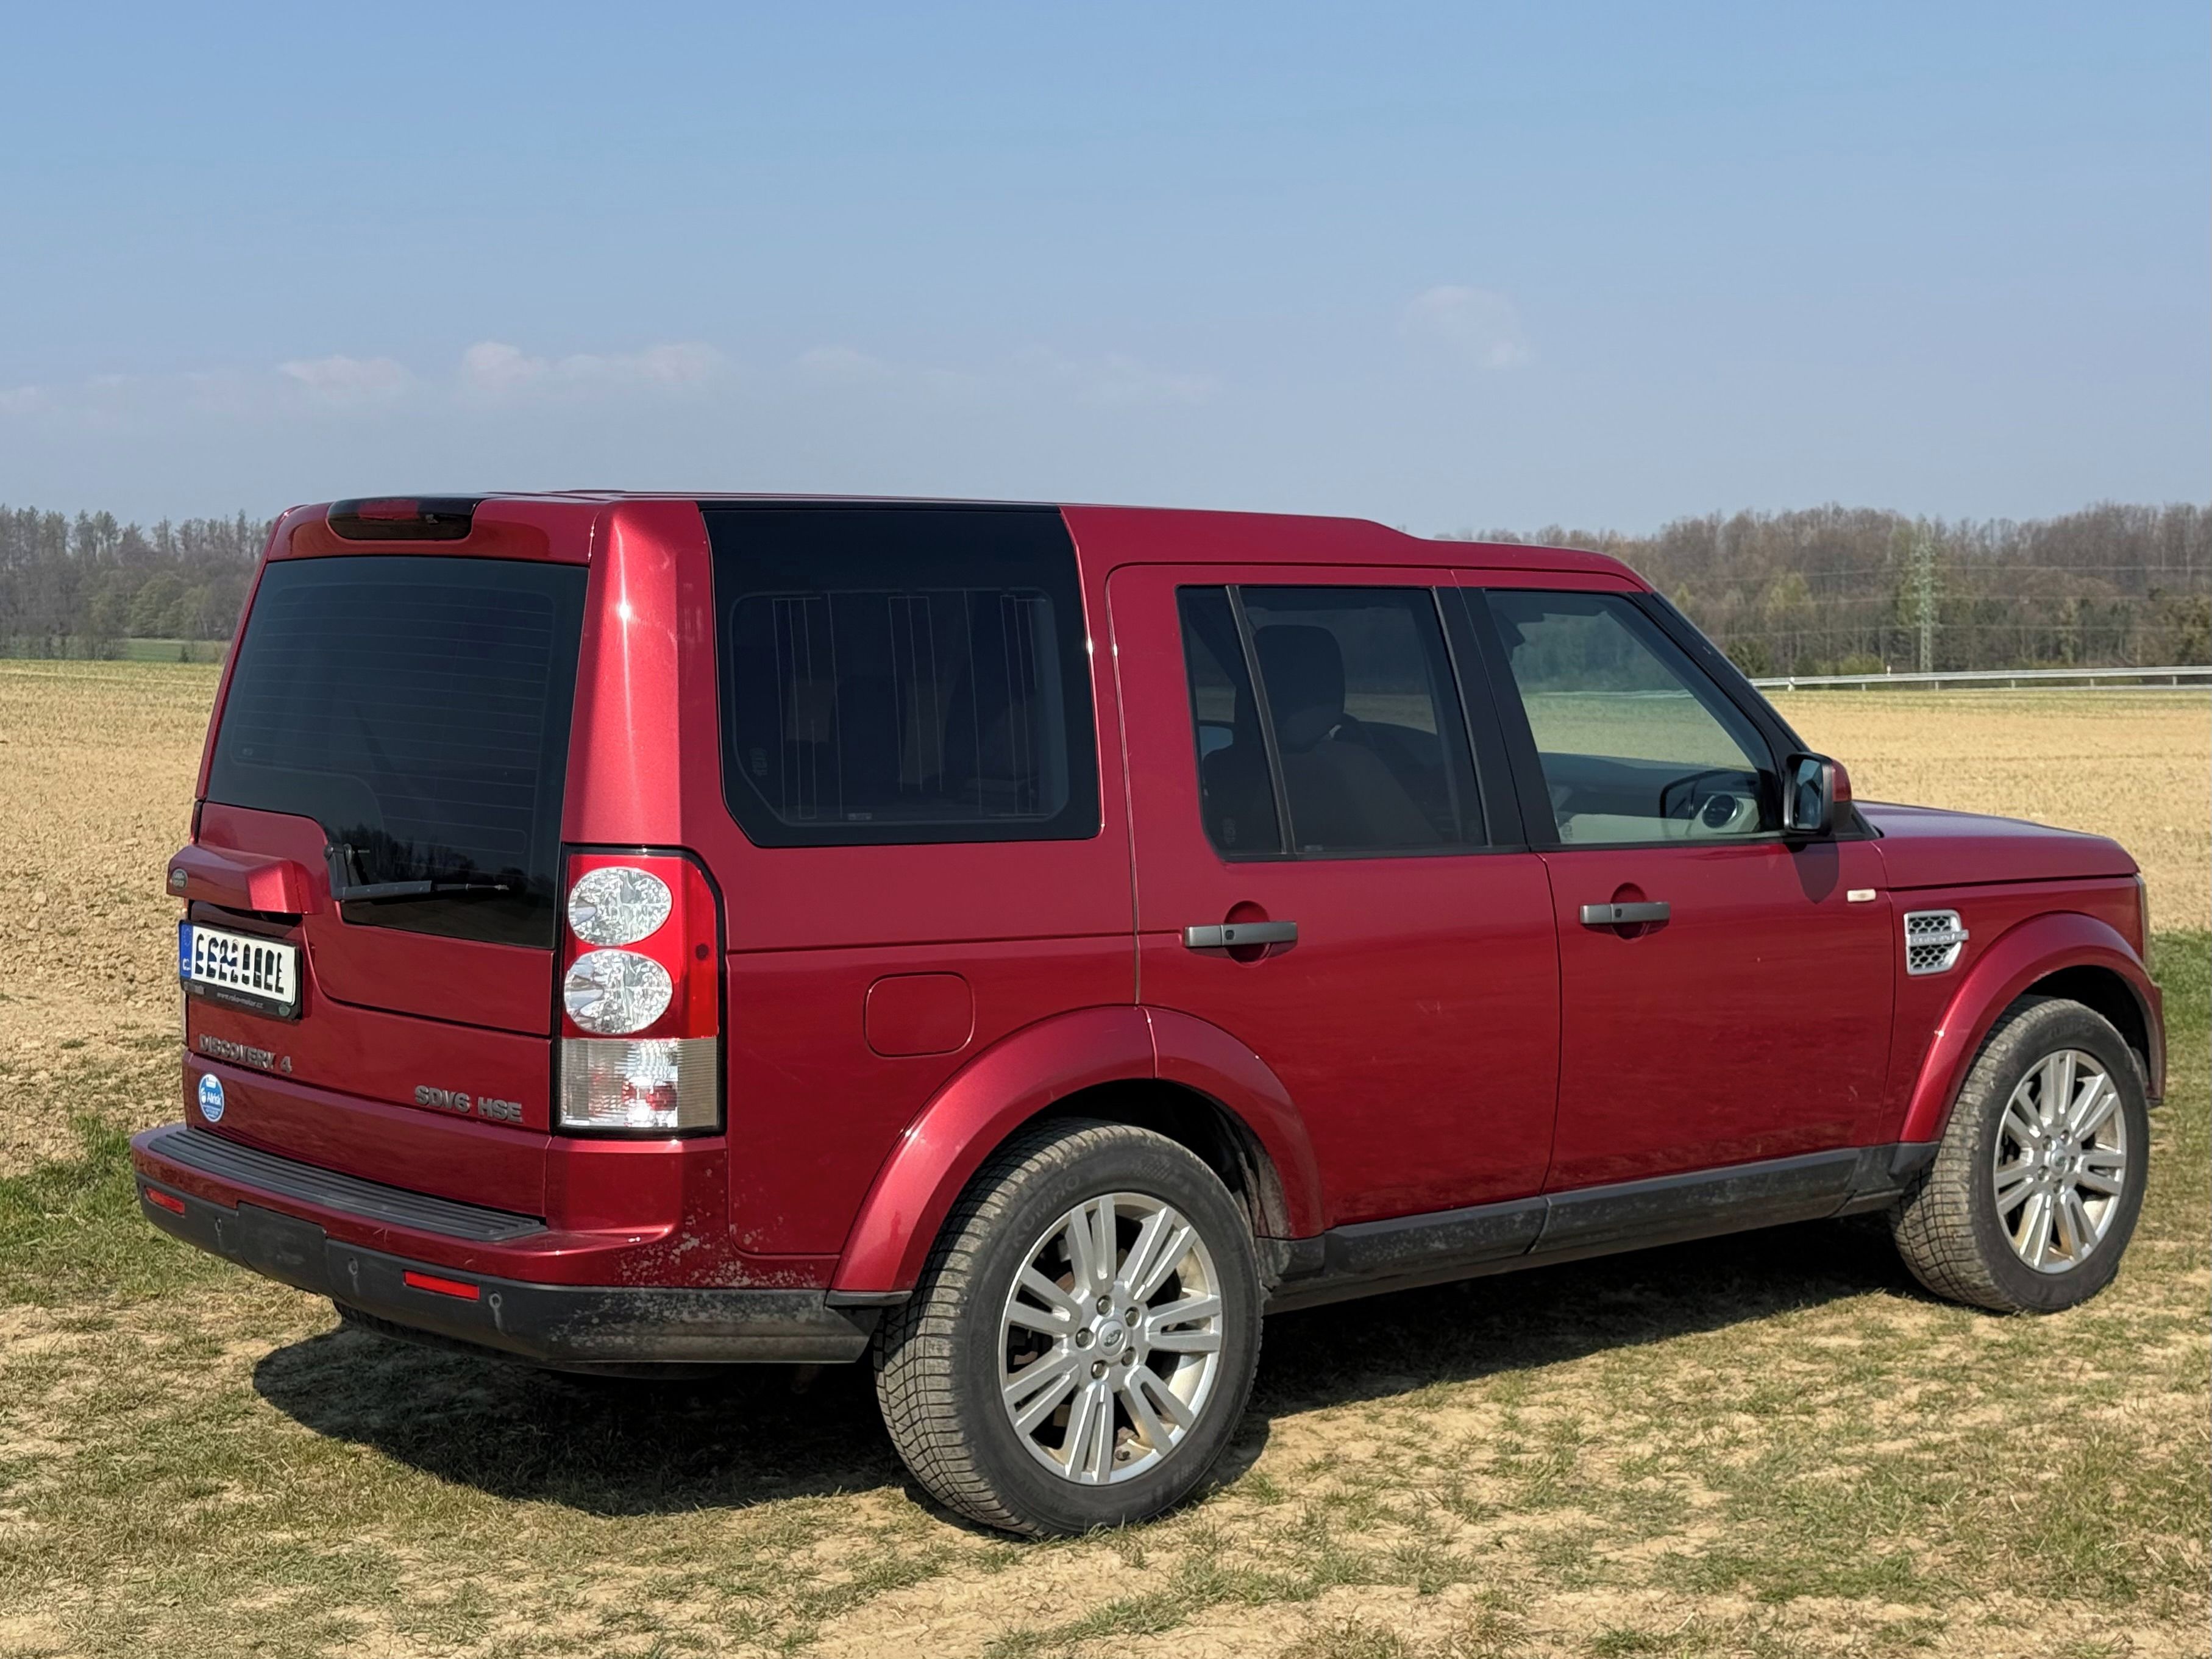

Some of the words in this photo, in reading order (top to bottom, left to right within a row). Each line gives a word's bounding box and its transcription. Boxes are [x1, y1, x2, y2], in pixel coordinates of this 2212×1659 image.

[199, 1034, 276, 1070] DISCOVERY
[280, 1056, 293, 1073] 4
[414, 1085, 471, 1113] SDV6
[478, 1096, 522, 1123] HSE
